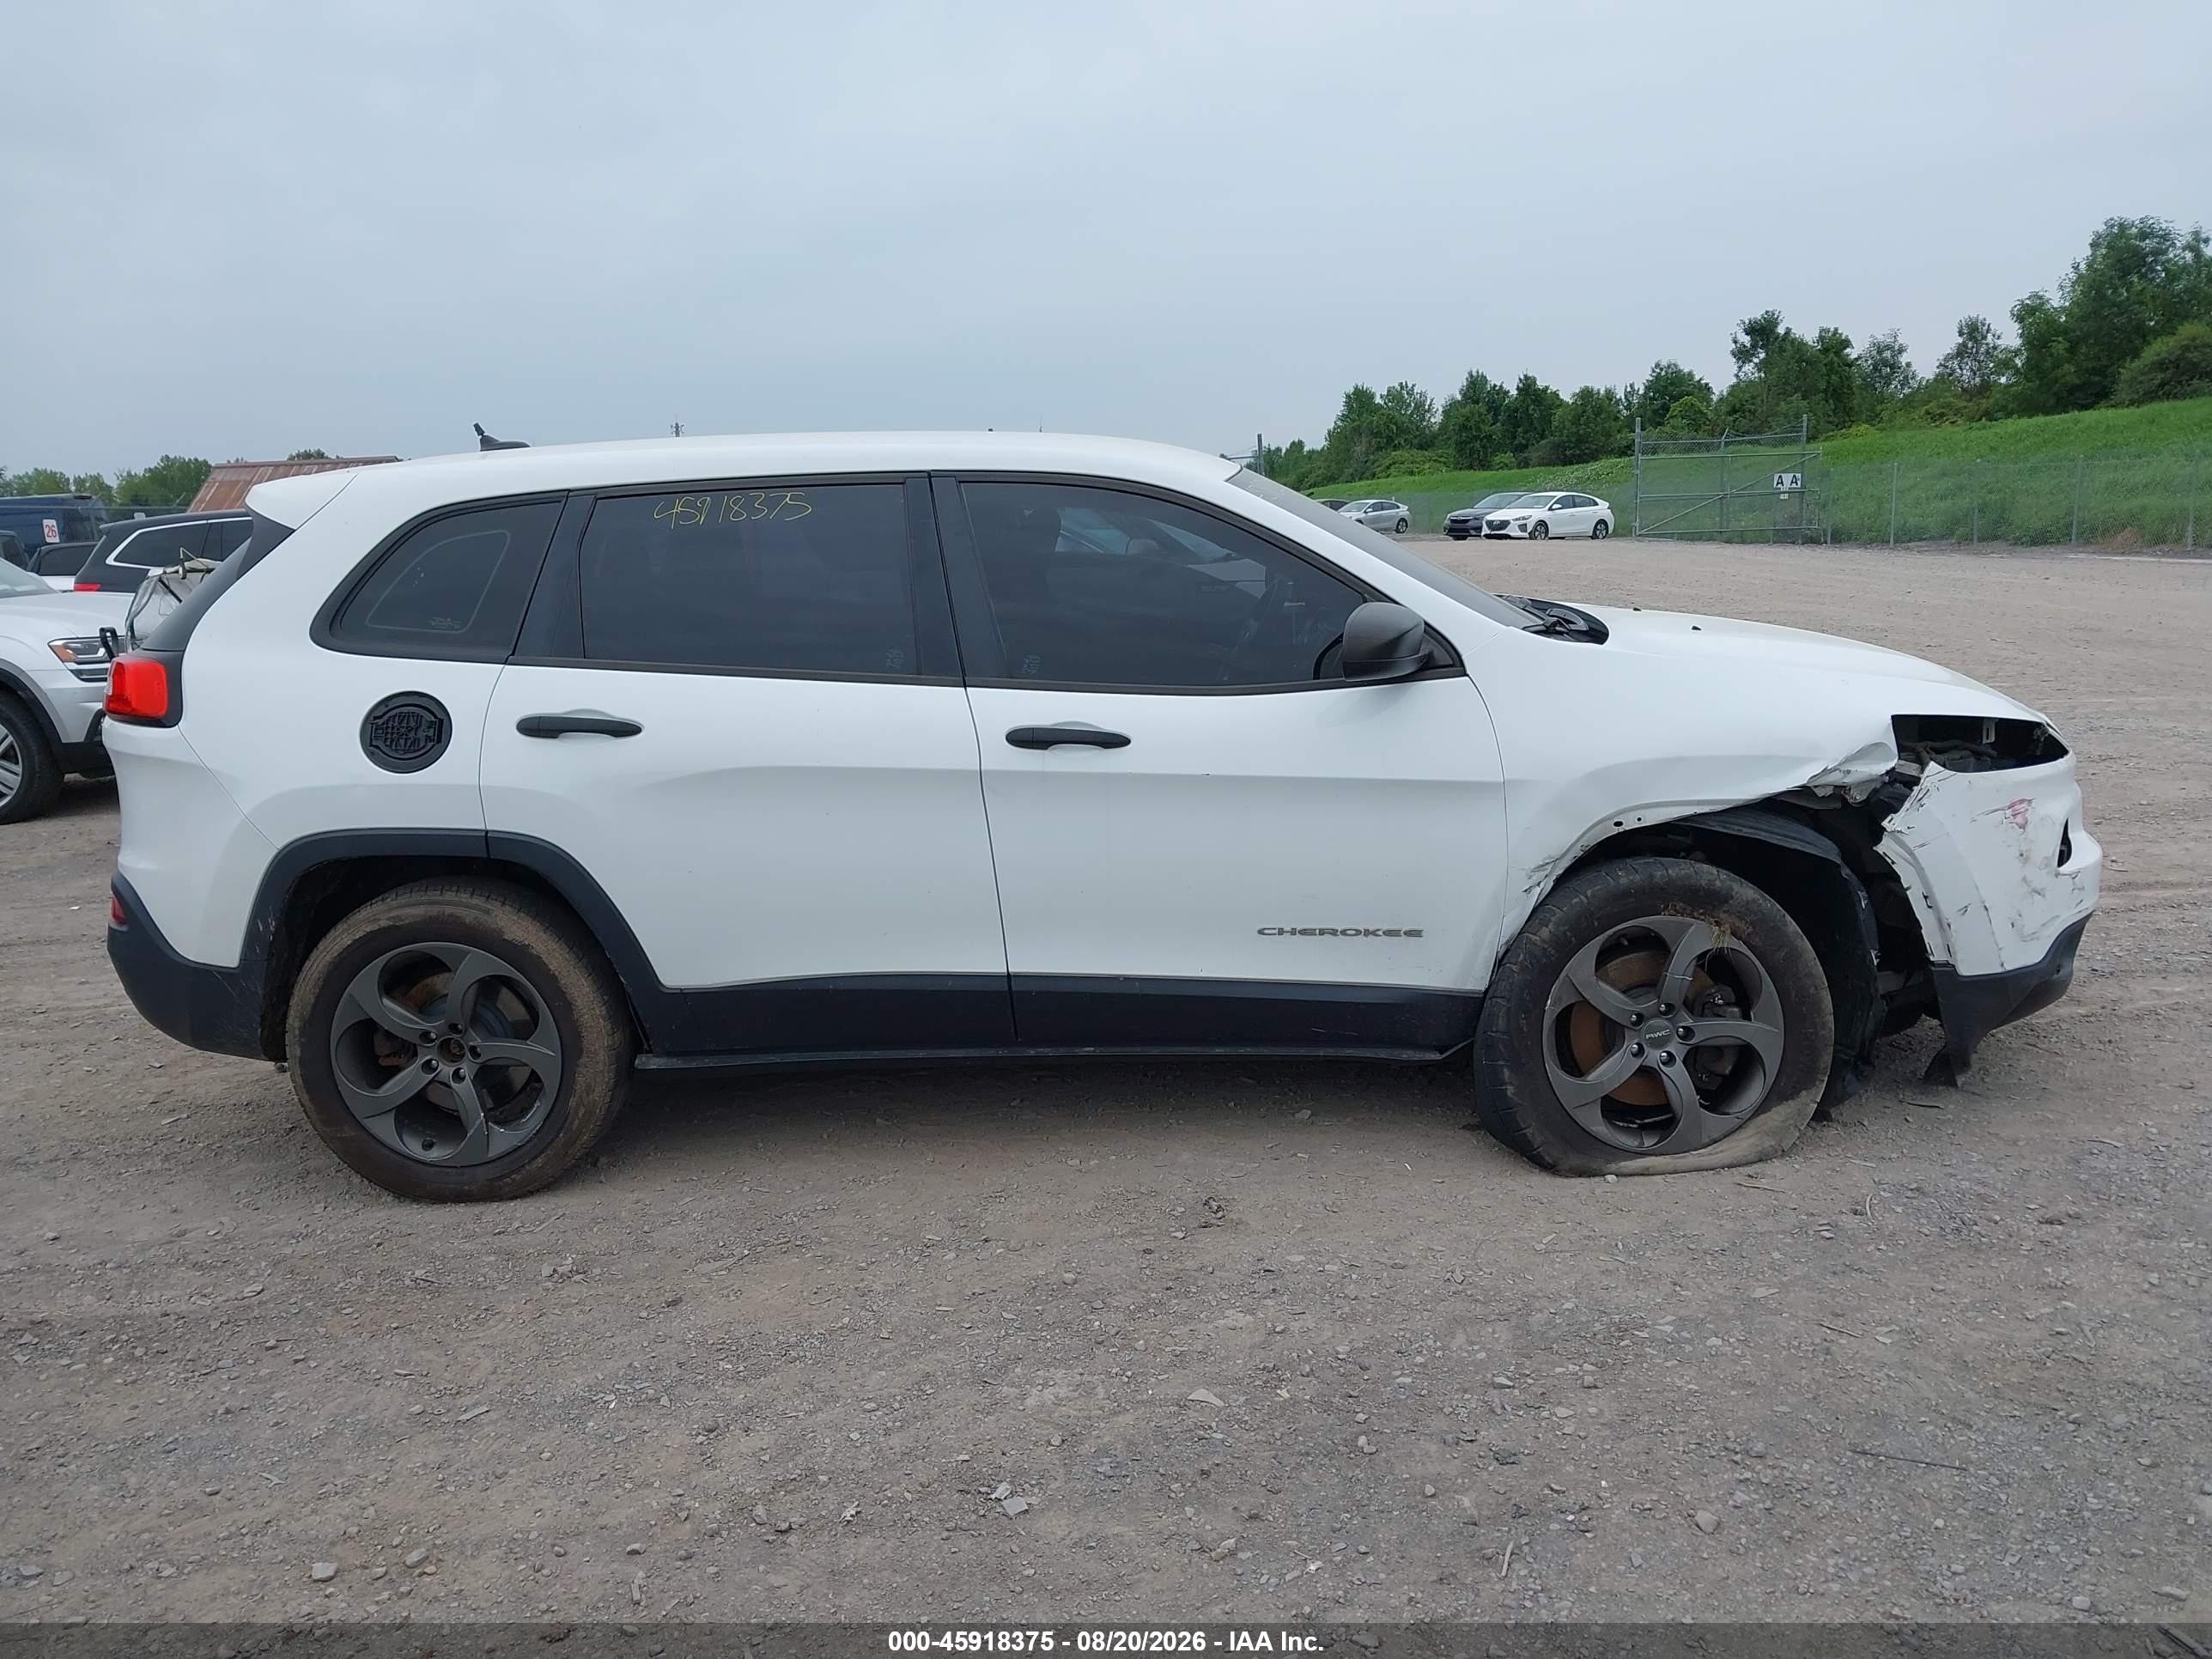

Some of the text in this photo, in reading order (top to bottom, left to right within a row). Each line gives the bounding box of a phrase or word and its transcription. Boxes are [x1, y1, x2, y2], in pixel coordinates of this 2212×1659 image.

[1776, 474, 1798, 487] A A
[653, 492, 812, 530] 45918375
[45, 524, 57, 538] 26
[1256, 927, 1425, 939] CHEROKEE
